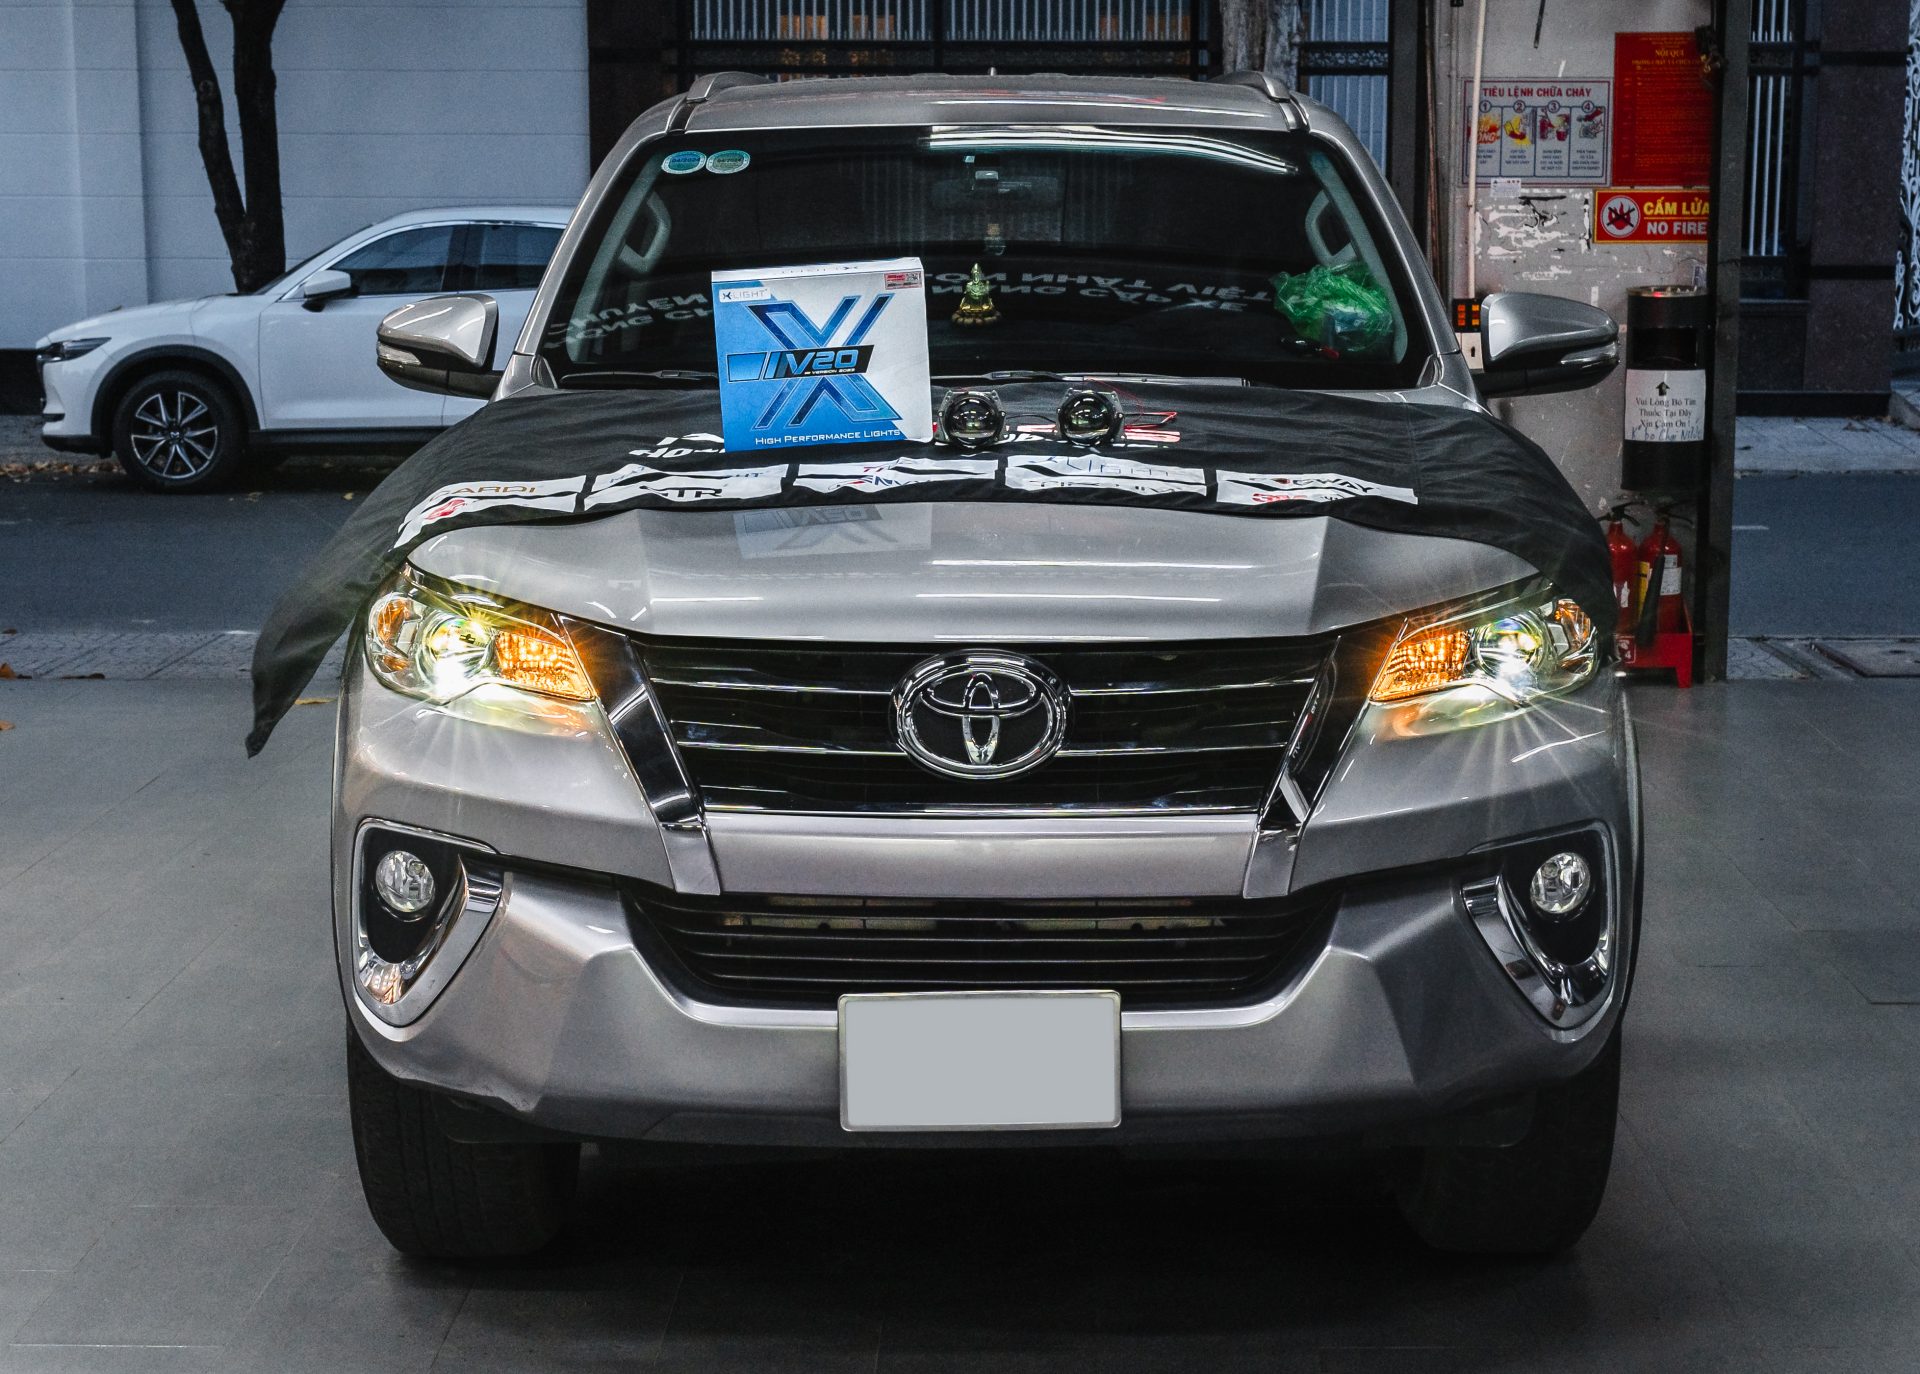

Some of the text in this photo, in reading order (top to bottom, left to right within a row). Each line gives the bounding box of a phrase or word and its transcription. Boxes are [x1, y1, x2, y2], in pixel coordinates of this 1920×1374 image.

[1508, 85, 1533, 98] LỆNH
[1516, 102, 1522, 111] 2
[1551, 102, 1557, 111] 3
[1585, 102, 1591, 111] 4
[1643, 196, 1677, 215] CẤM
[1647, 221, 1707, 235] NO FIRE
[786, 350, 859, 375] V20
[755, 429, 901, 446] HIGH PERFORMANCE LIGHTS
